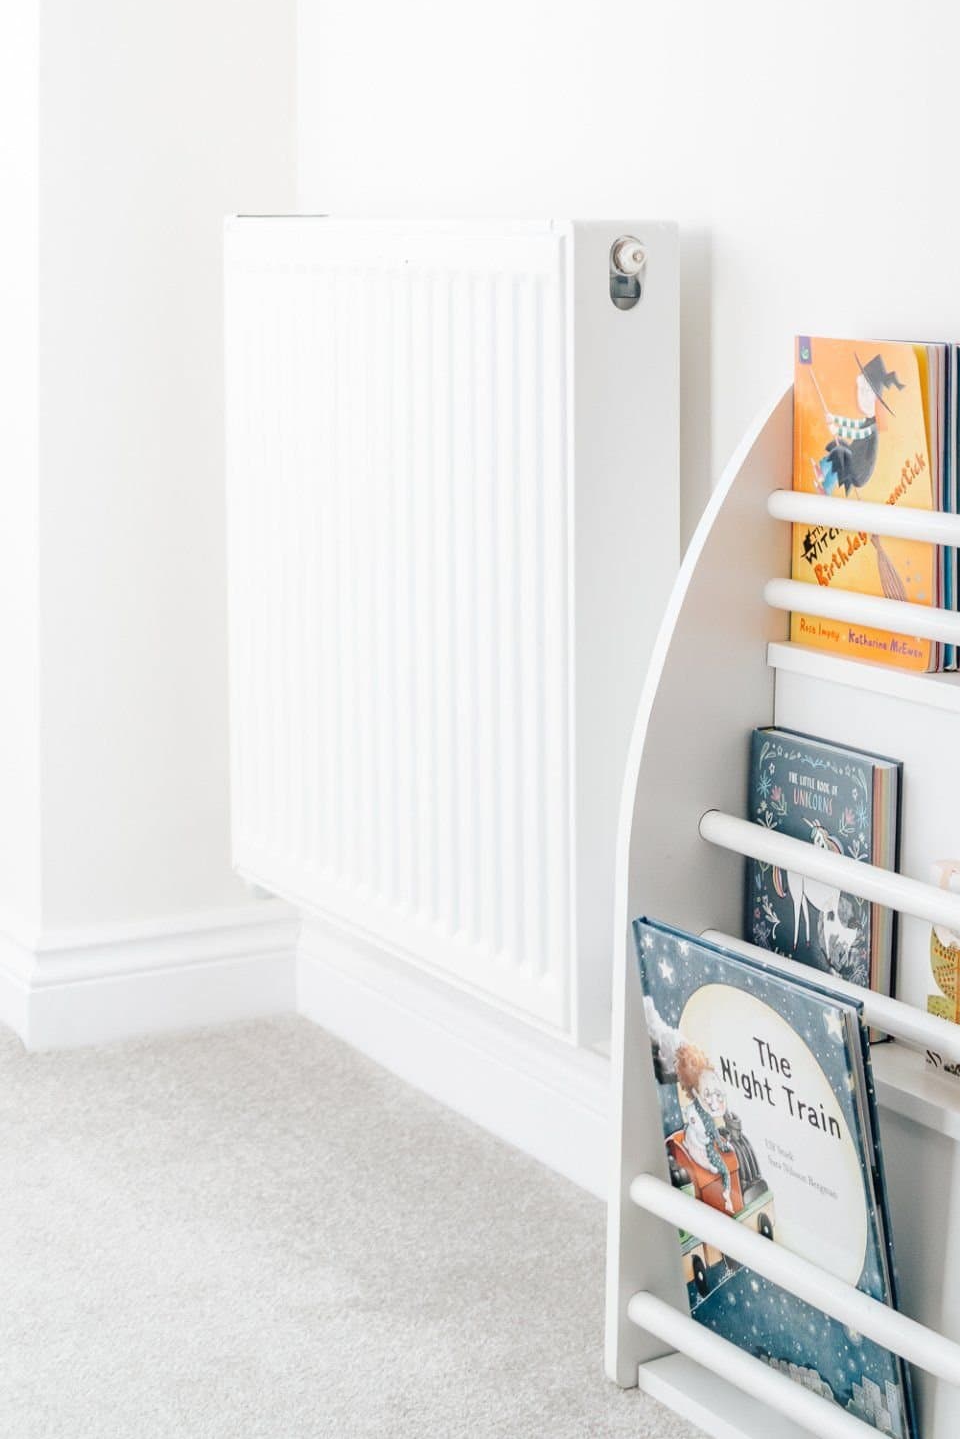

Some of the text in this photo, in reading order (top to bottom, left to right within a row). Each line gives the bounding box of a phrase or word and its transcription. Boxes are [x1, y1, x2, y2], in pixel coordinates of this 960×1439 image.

[793, 787, 833, 816] UNICORNS
[753, 1036, 792, 1079] The
[719, 1055, 842, 1140] Night Train
